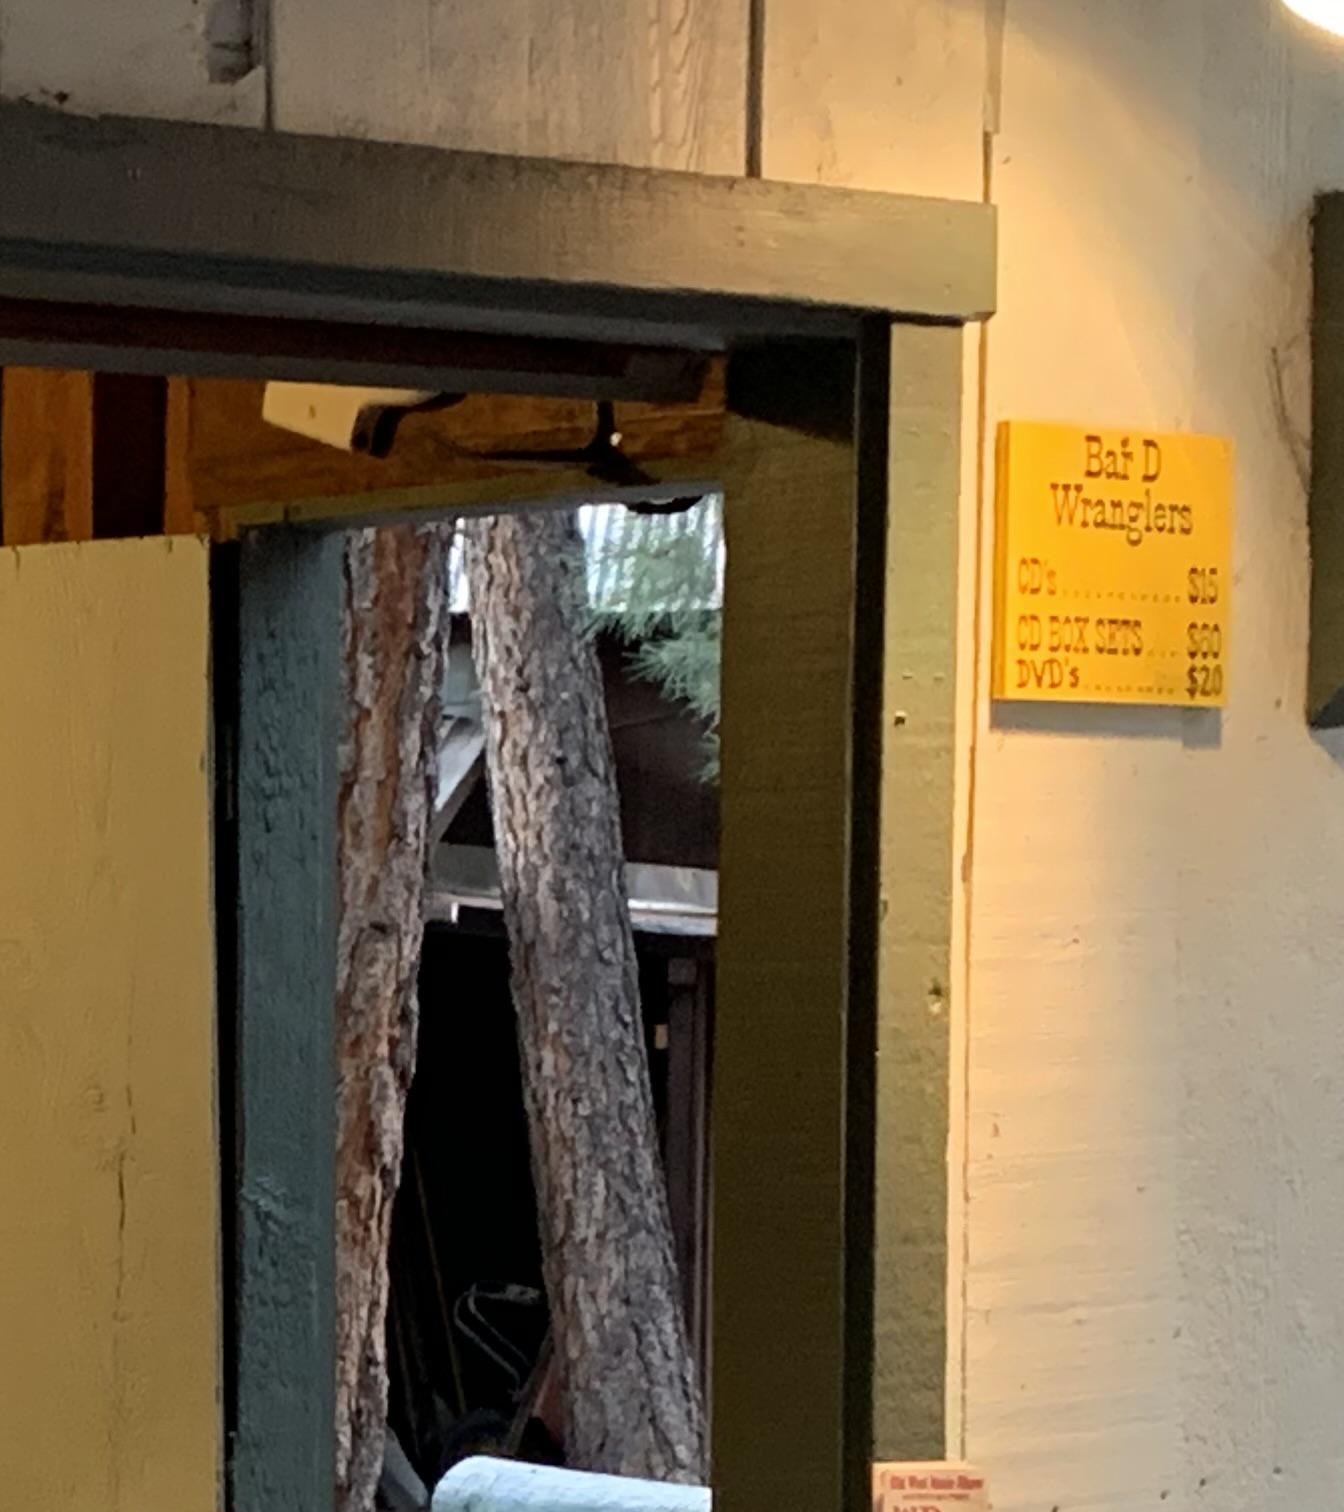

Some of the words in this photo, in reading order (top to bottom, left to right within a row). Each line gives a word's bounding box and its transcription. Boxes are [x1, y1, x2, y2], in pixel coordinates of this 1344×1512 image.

[1085, 435, 1134, 480] Bar
[1142, 439, 1162, 482] D
[1050, 483, 1193, 547] Wranglers
[1095, 617, 1143, 656] SETS
[1016, 658, 1080, 690] DVD's
[1187, 664, 1223, 699] $20
